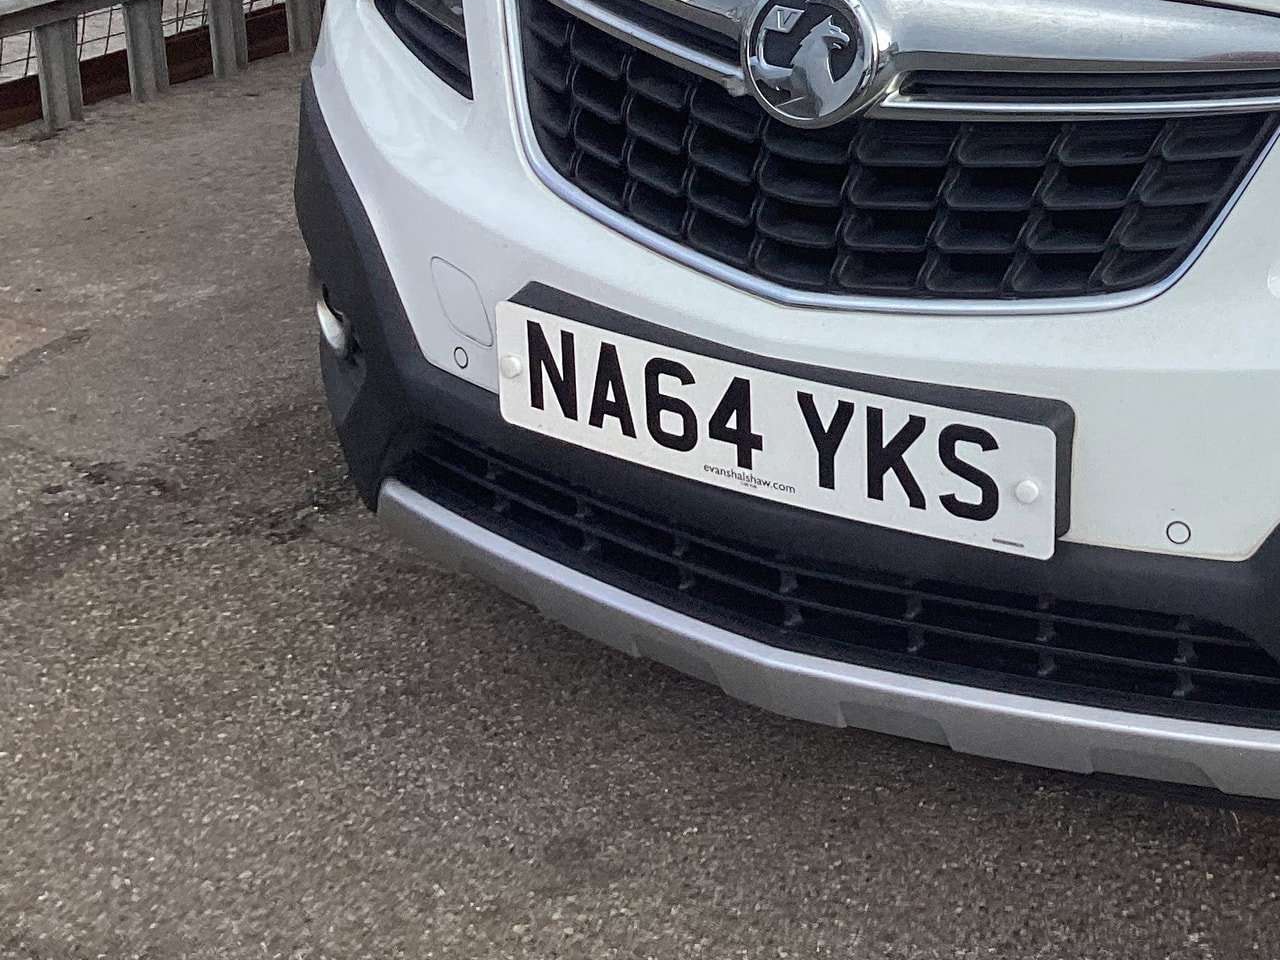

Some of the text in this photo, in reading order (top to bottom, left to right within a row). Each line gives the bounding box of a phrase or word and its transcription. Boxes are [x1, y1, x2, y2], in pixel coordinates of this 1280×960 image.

[526, 320, 1000, 522] NA64 YKS
[703, 464, 796, 494] evanshalshaw.com
